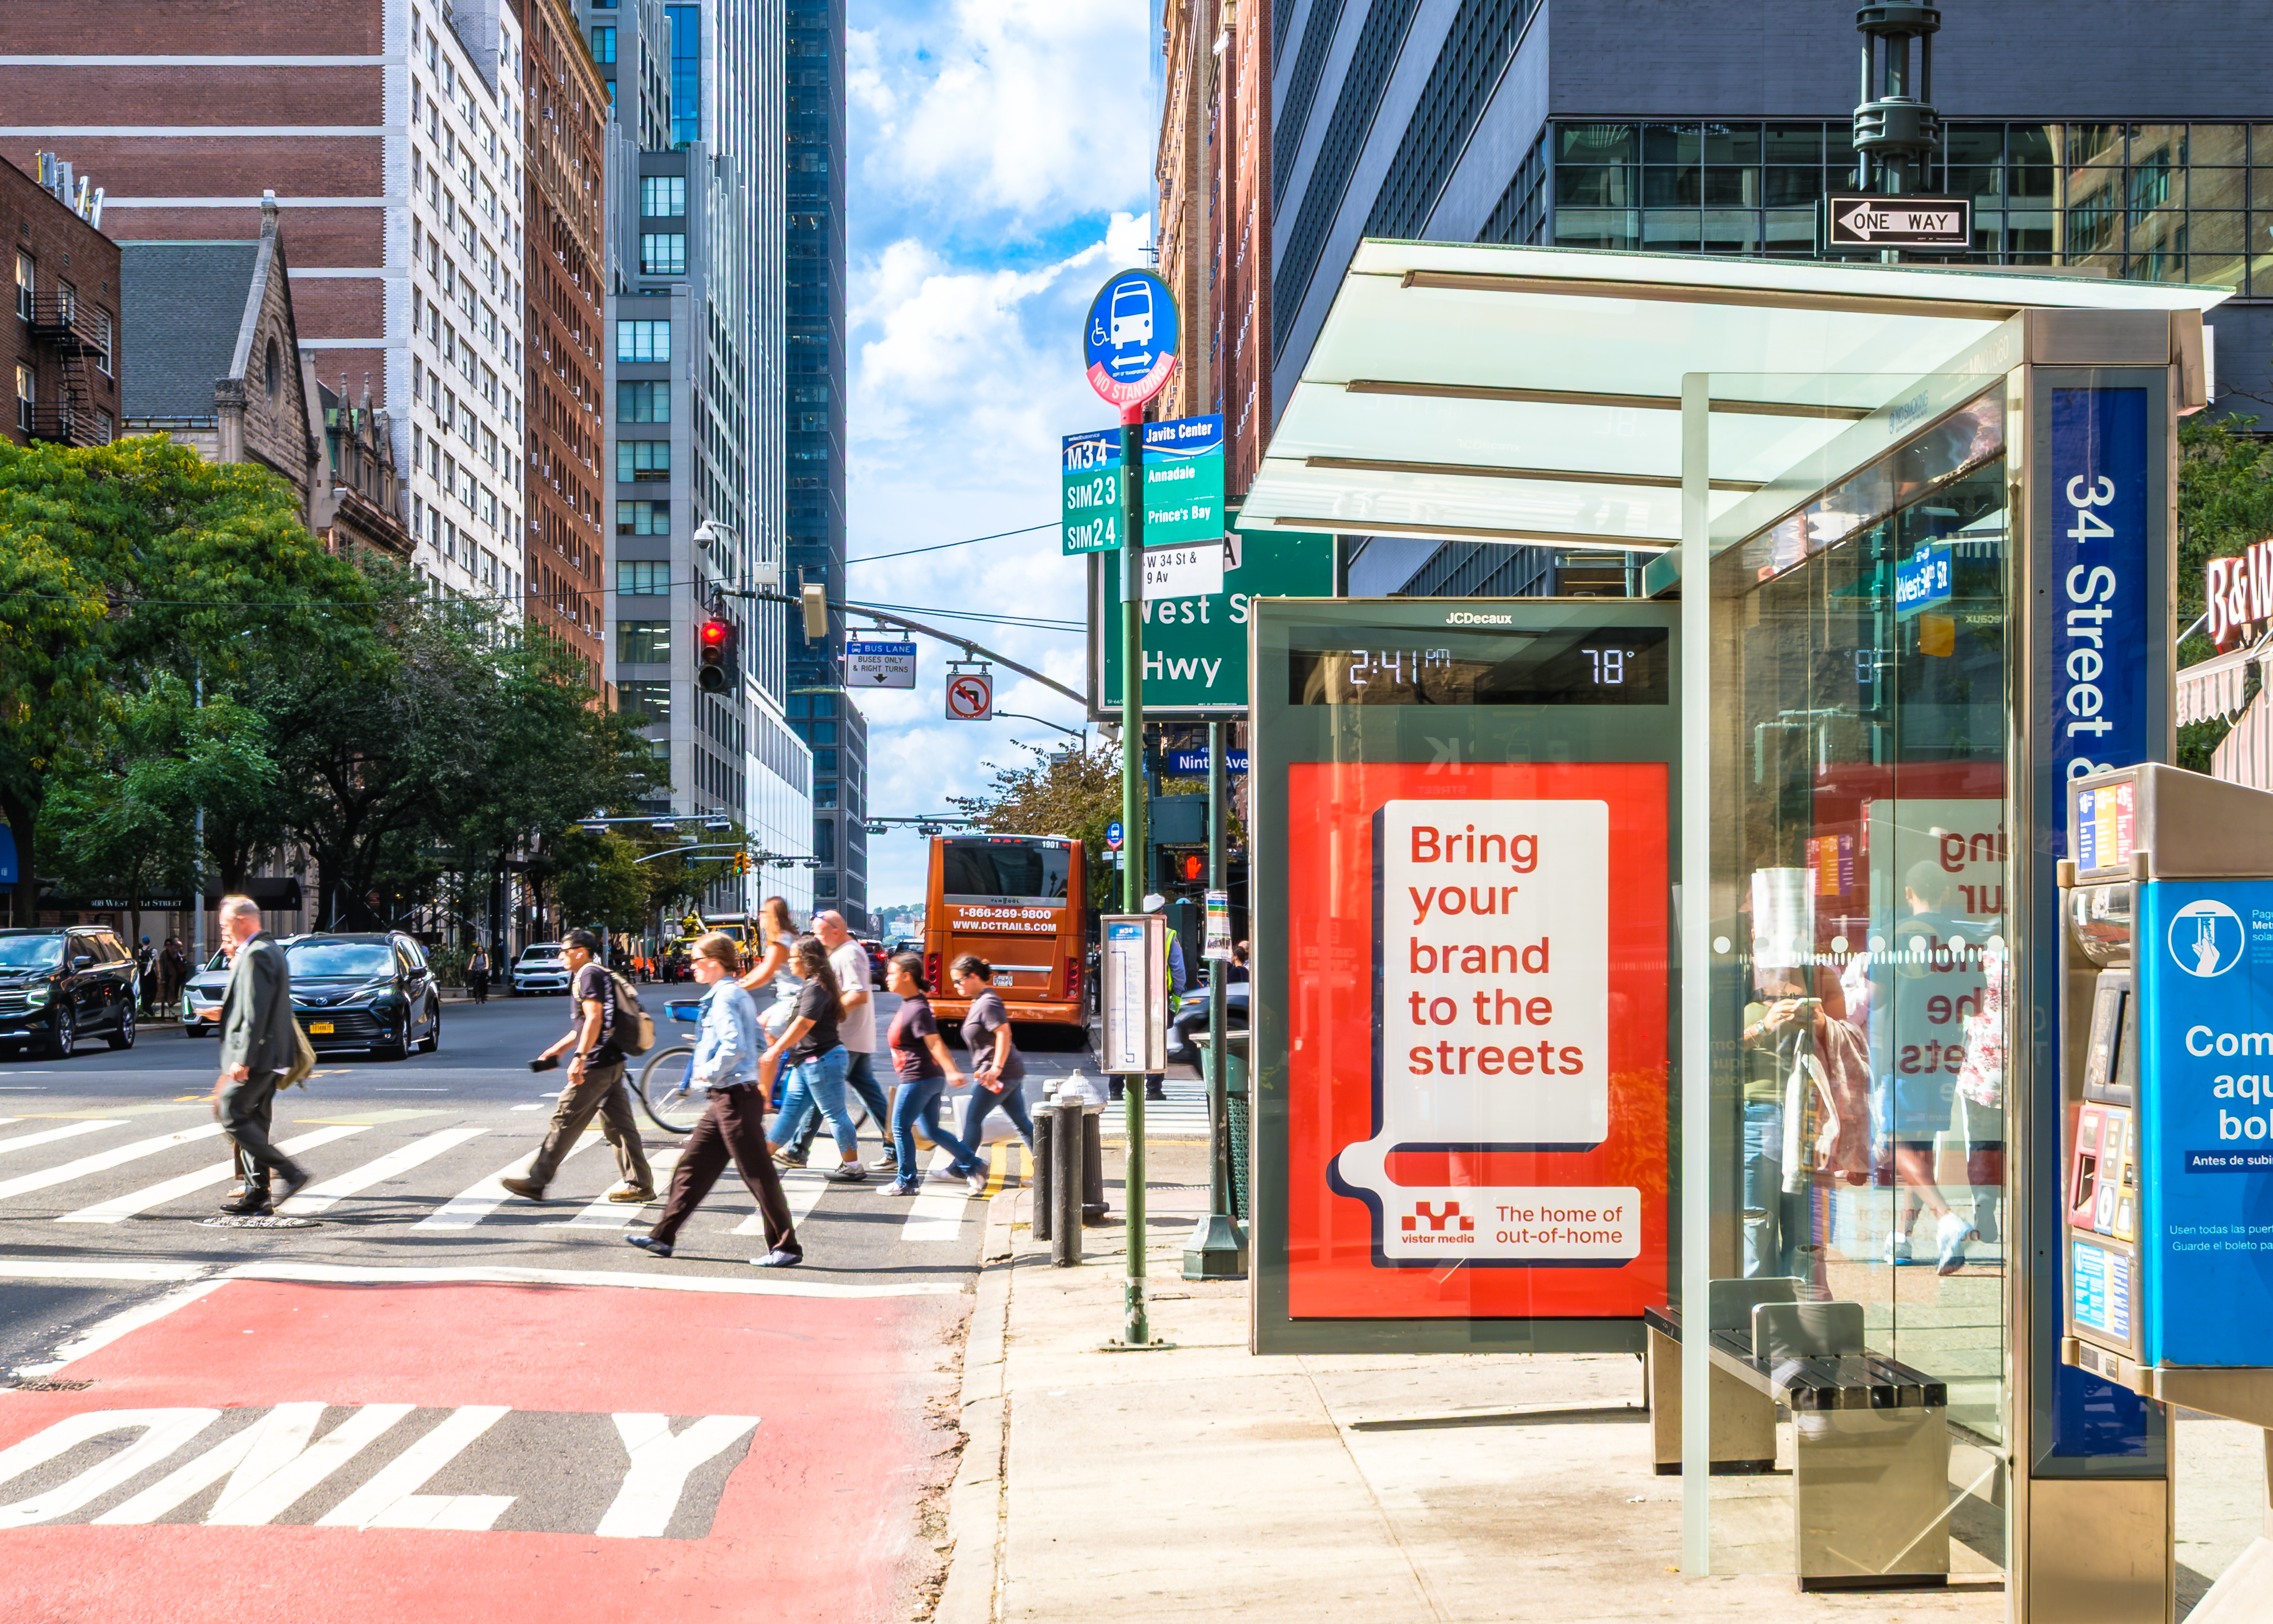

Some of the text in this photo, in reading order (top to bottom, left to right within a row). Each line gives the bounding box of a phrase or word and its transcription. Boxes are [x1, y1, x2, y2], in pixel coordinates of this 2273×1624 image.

[1854, 213, 1948, 230] ONE WAY
[1969, 335, 2009, 382] MN01060
[1093, 362, 1167, 400] NO STANDING
[1146, 423, 1212, 443] Javits Center
[1068, 438, 1107, 470] M34
[1148, 465, 1195, 483] Annadale
[1067, 476, 1116, 509] SIM23
[1148, 505, 1211, 524] Prince's Bay
[2066, 475, 2115, 543] 34
[1067, 517, 1116, 550] SIM24
[1147, 552, 1197, 568] W 34 St &
[1147, 571, 1168, 584] 9 Av
[1446, 613, 1512, 625] JCDecaux
[2066, 564, 2116, 738] Street
[1142, 650, 1222, 688] Hwy
[1350, 650, 1417, 684] 2:41
[1425, 649, 1451, 668] PM
[1180, 756, 1210, 769] Nint
[1412, 824, 1538, 874] Bring
[959, 908, 1051, 919] 1-866-269-9800
[1408, 885, 1518, 925] your
[953, 921, 1056, 931] WWW.DCTRAILS.COM
[2252, 931, 2273, 940] sola
[1410, 937, 1549, 974] brand
[1408, 989, 1553, 1026] to the
[1408, 1041, 1584, 1076] streets
[2192, 1155, 2273, 1165] Antes de subi
[1496, 1206, 1623, 1222] The home of
[1402, 1234, 1474, 1244] vistar media
[1496, 1228, 1623, 1244] out-of-home
[2170, 1225, 2196, 1235] Usen
[2199, 1225, 2228, 1234] todas
[2231, 1224, 2245, 1234] las
[2172, 1241, 2210, 1251] Guarde
[2214, 1241, 2222, 1250] el
[2225, 1240, 2257, 1250] boleto
[0, 1401, 762, 1537] ONLY
